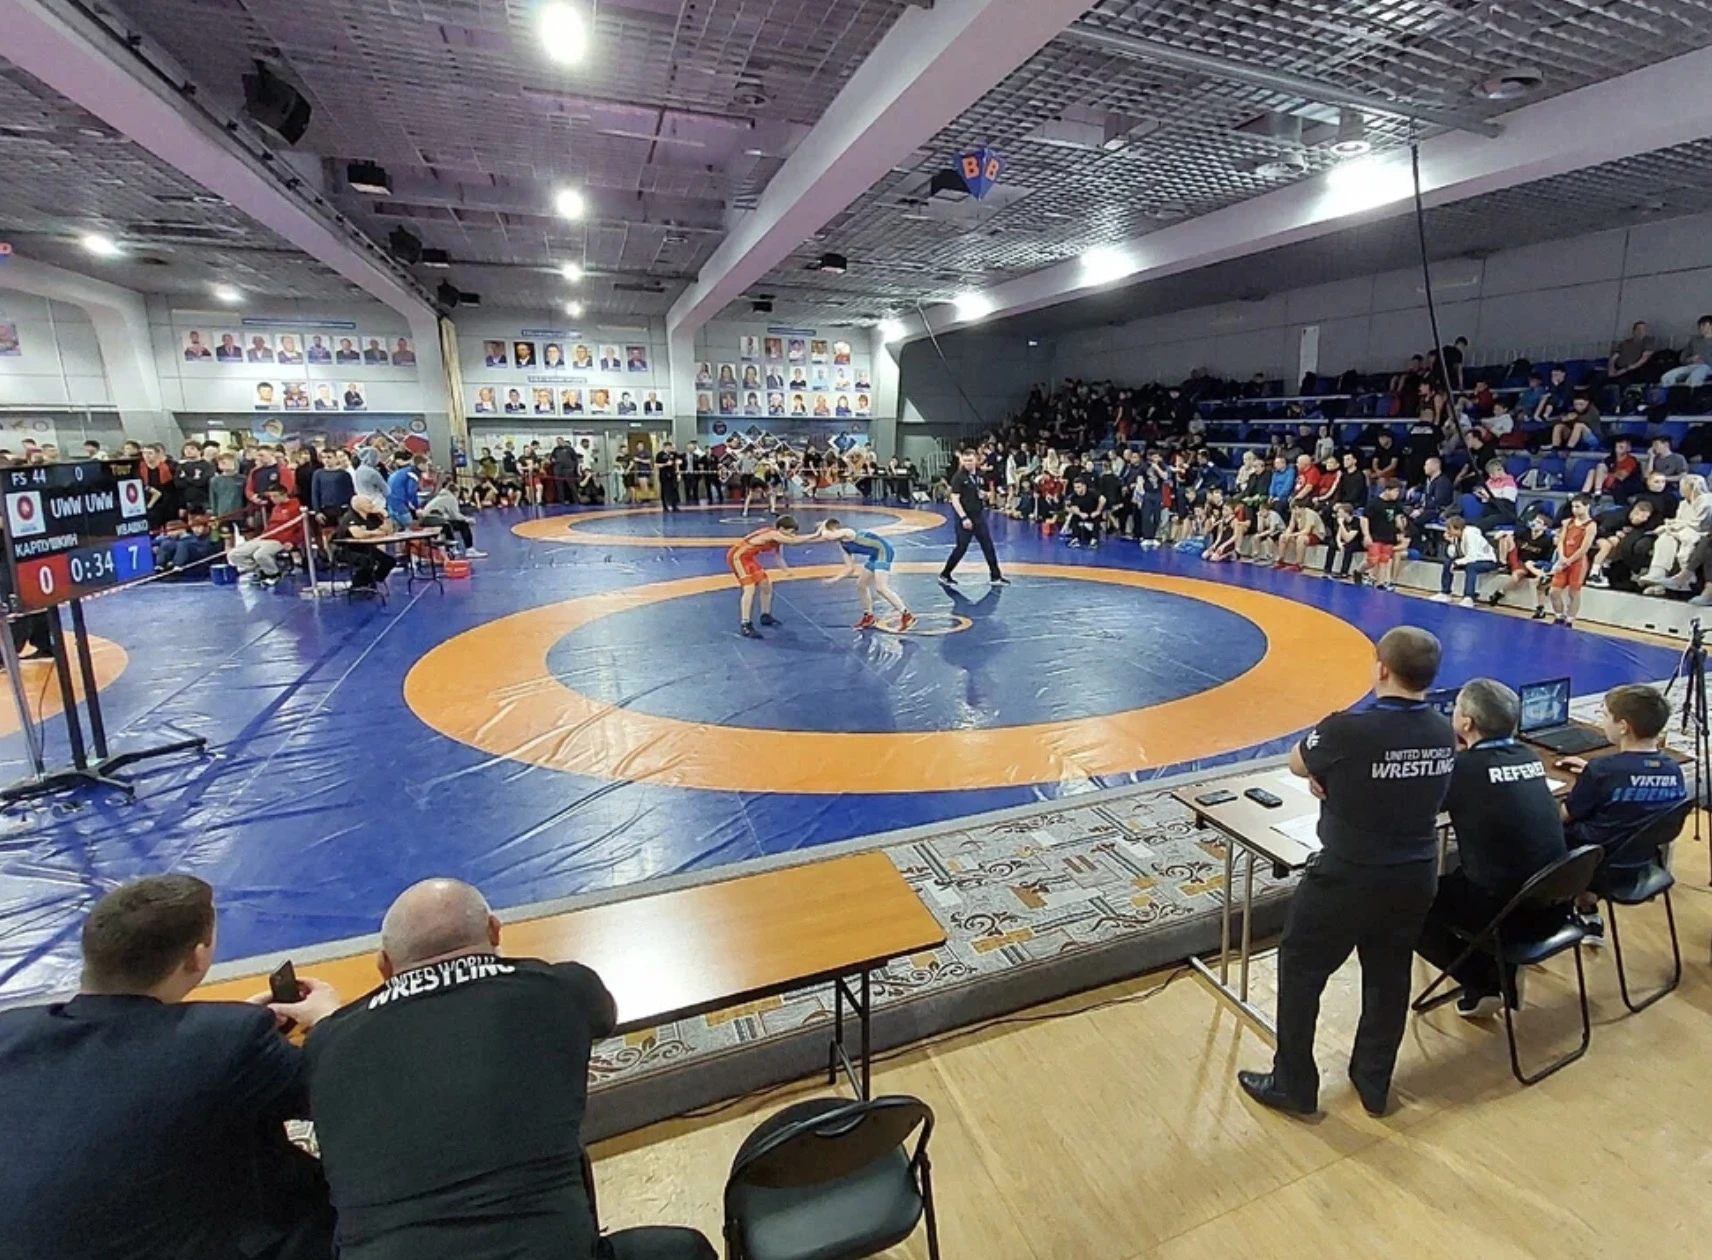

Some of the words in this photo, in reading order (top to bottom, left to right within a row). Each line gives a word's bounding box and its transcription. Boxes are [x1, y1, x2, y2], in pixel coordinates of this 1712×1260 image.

[11, 472, 27, 486] FS
[32, 469, 46, 483] 44
[75, 466, 83, 481] 0
[51, 496, 82, 518] UWW
[86, 492, 114, 512] UWW
[71, 550, 115, 582] 0:34
[128, 546, 138, 570] 7
[40, 566, 53, 595] 0
[1385, 750, 1420, 761] UNITED
[1421, 747, 1452, 759] WORLD
[1371, 758, 1455, 779] WRESTLING
[1630, 775, 1678, 787] VIKTOR
